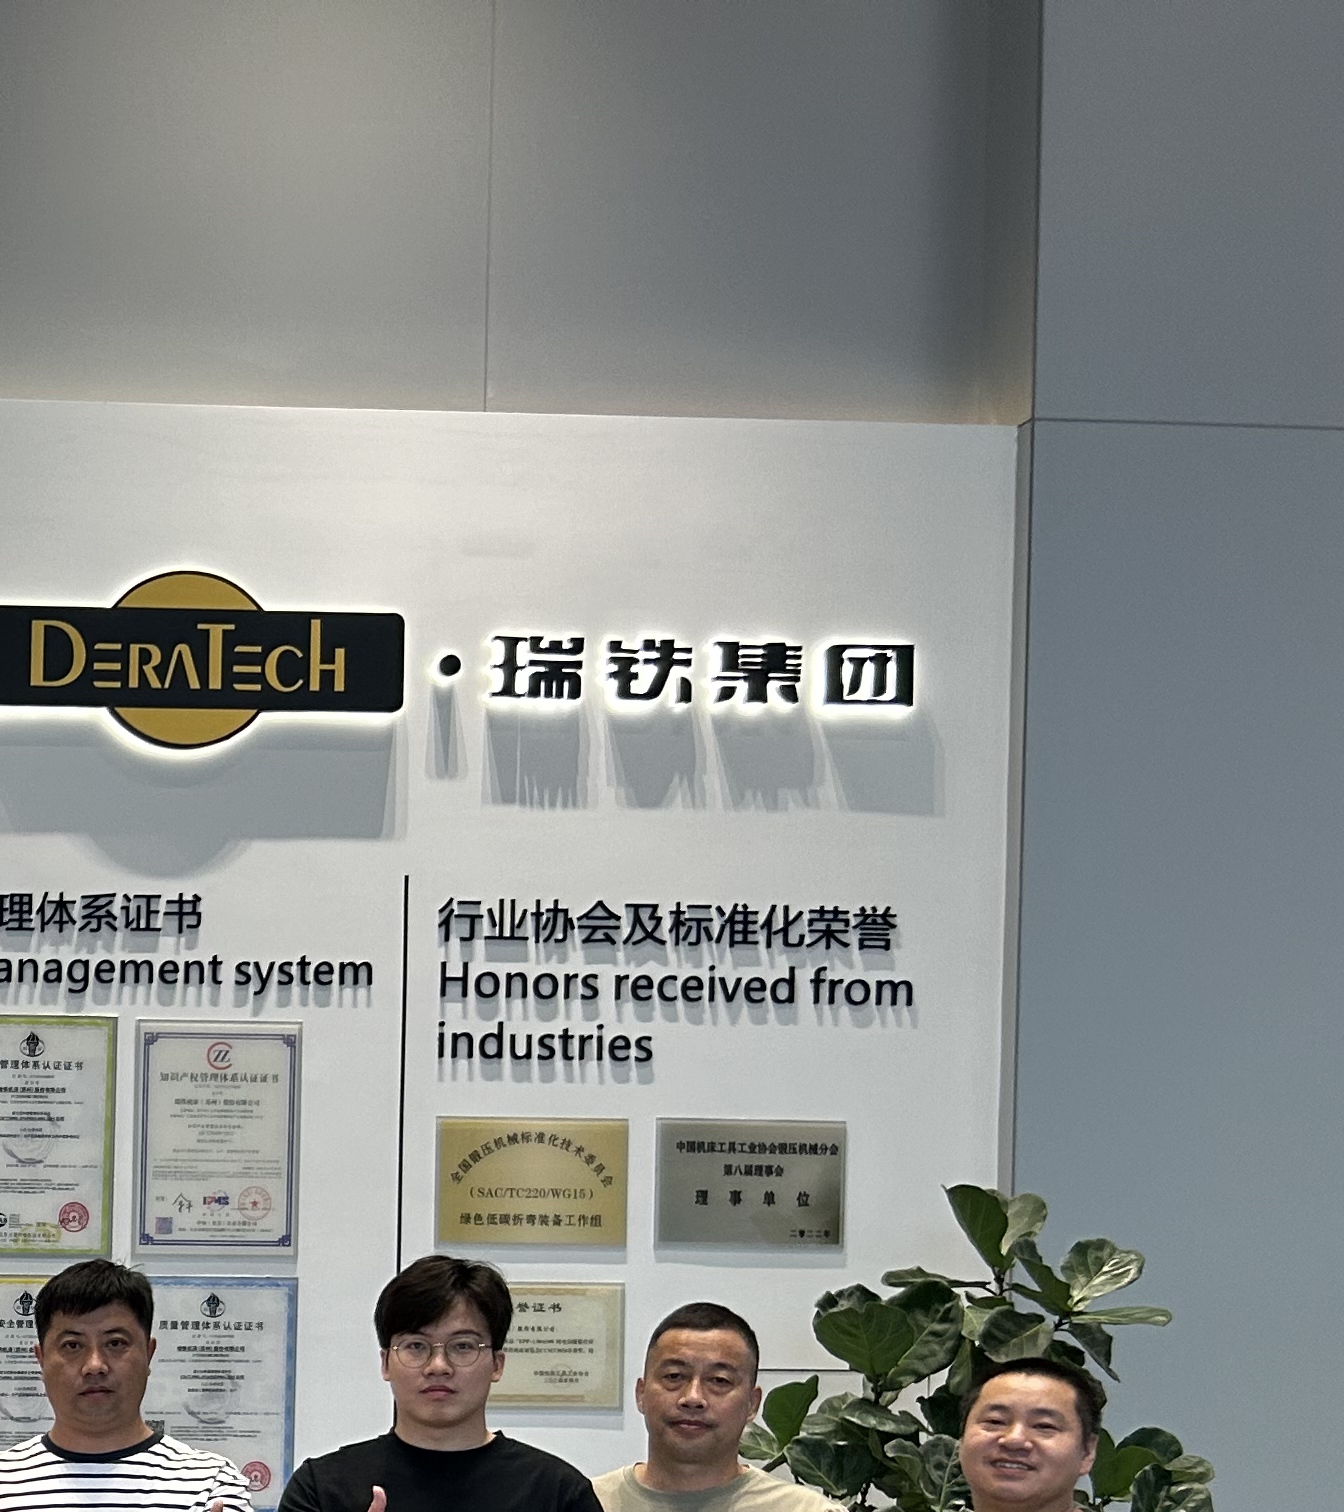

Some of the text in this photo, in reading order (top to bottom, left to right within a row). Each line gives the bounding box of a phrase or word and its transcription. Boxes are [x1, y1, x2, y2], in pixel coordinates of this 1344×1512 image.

[489, 634, 914, 708] 瑞铁集团
[437, 897, 897, 951] 行业协会及标准化荣誉
[235, 955, 373, 995] system
[439, 961, 914, 1007] Honors received from
[438, 1021, 653, 1063] industries
[695, 1189, 810, 1207] 理事单位
